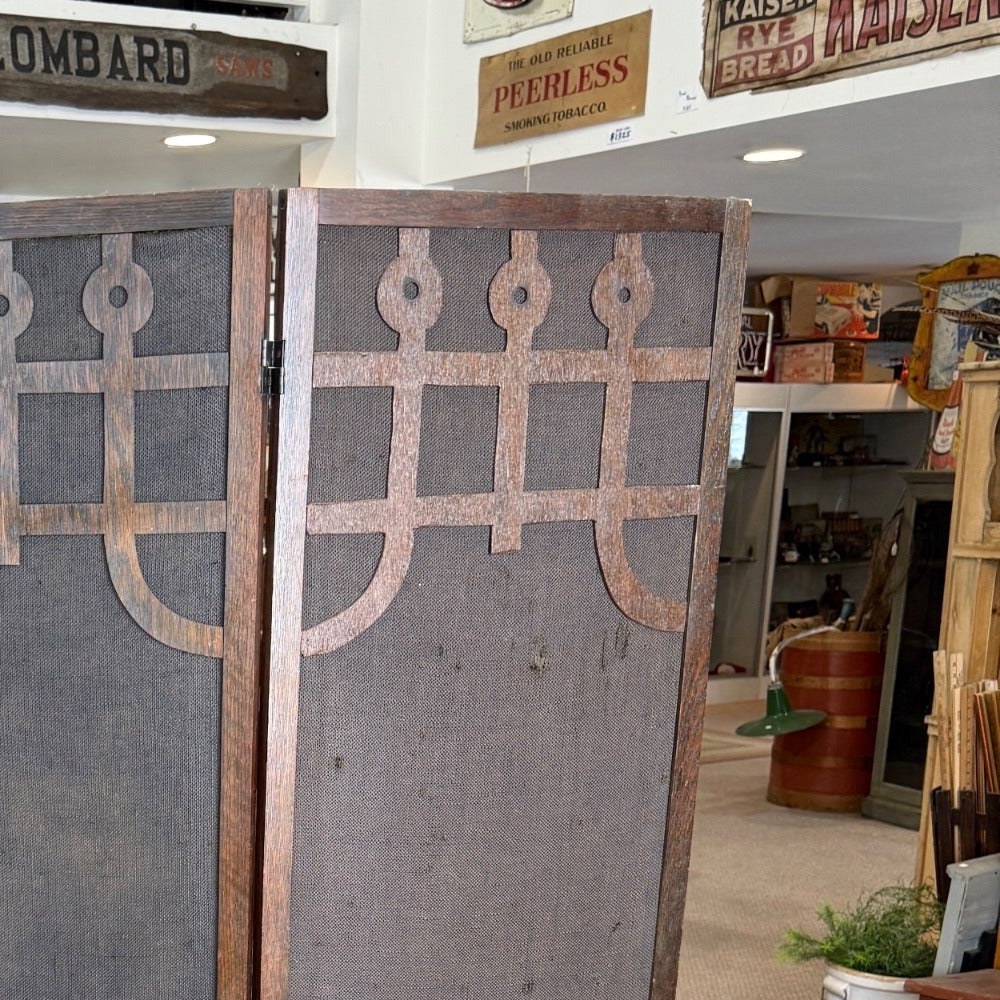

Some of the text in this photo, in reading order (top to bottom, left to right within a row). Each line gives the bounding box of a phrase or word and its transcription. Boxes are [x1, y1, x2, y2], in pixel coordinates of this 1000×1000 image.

[738, 16, 797, 49] RYE
[824, 0, 1000, 58] KAIS
[216, 55, 273, 79] SAWS
[508, 34, 613, 71] THE OLD RELIABLE
[721, 44, 807, 83] BREAD
[493, 54, 629, 114] PEERLESS
[504, 113, 550, 133] SMOKING
